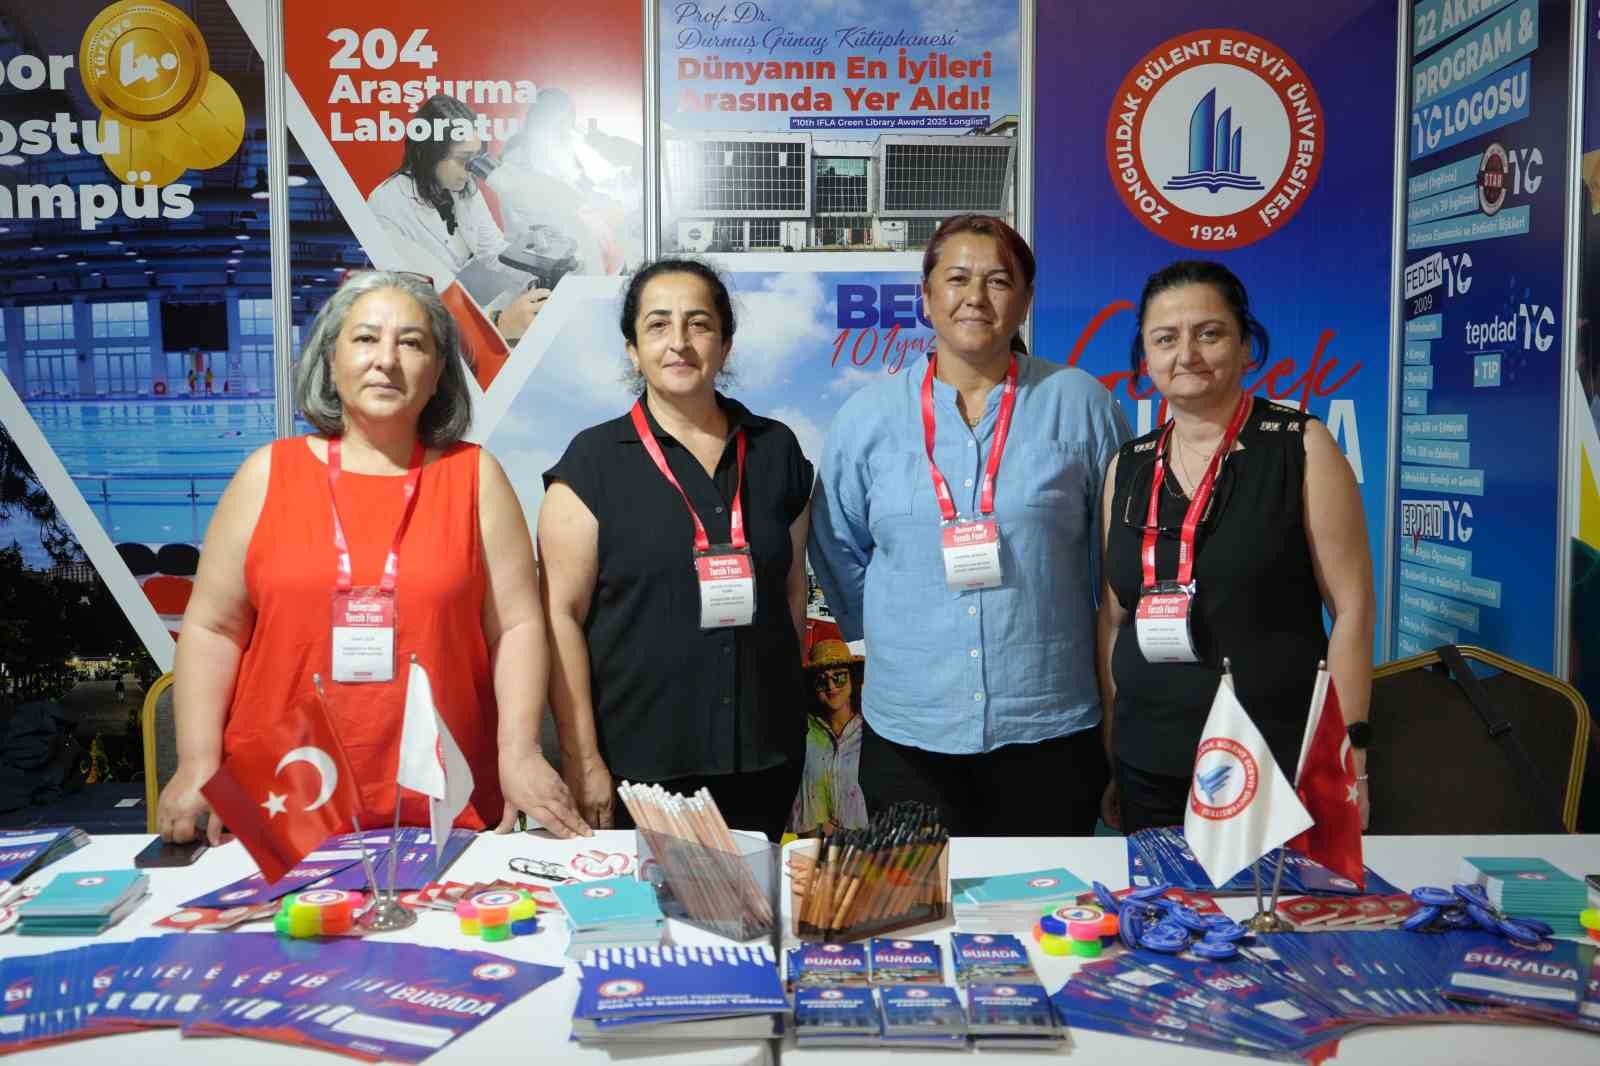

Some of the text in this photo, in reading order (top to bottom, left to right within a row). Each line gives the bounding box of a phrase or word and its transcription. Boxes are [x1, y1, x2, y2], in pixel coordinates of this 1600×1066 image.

[675, 2, 772, 31] Prof. Dr.
[1417, 9, 1437, 46] 22
[327, 28, 438, 70] 204
[675, 25, 959, 55] Durmuş Günay Kütüphanesi
[1416, 8, 1533, 103] PROGRAM &
[677, 48, 992, 86] Dünyanın En İyileri
[328, 74, 537, 113] Araştırma
[677, 86, 990, 113] Arasında Yer Aldı!
[1445, 71, 1527, 136] LOGOSU
[817, 118, 835, 127] IFLA
[838, 117, 863, 127] Green
[865, 117, 895, 129] Library
[898, 117, 925, 127] Award
[926, 117, 947, 127] 2025
[1115, 39, 1317, 227] ZONGULDAK BÜLENT ECEVİT ÜNİVERSİTESİ
[1190, 225, 1237, 240] 1924
[1406, 257, 1440, 290] FEDEK
[1414, 294, 1432, 315] 2009
[1466, 313, 1517, 350] tepdad
[1481, 360, 1498, 381] TIP
[804, 956, 862, 968] BURADA
[875, 954, 934, 966] BURADA
[1463, 951, 1580, 982] BURADA
[392, 985, 497, 1017] BURADA
